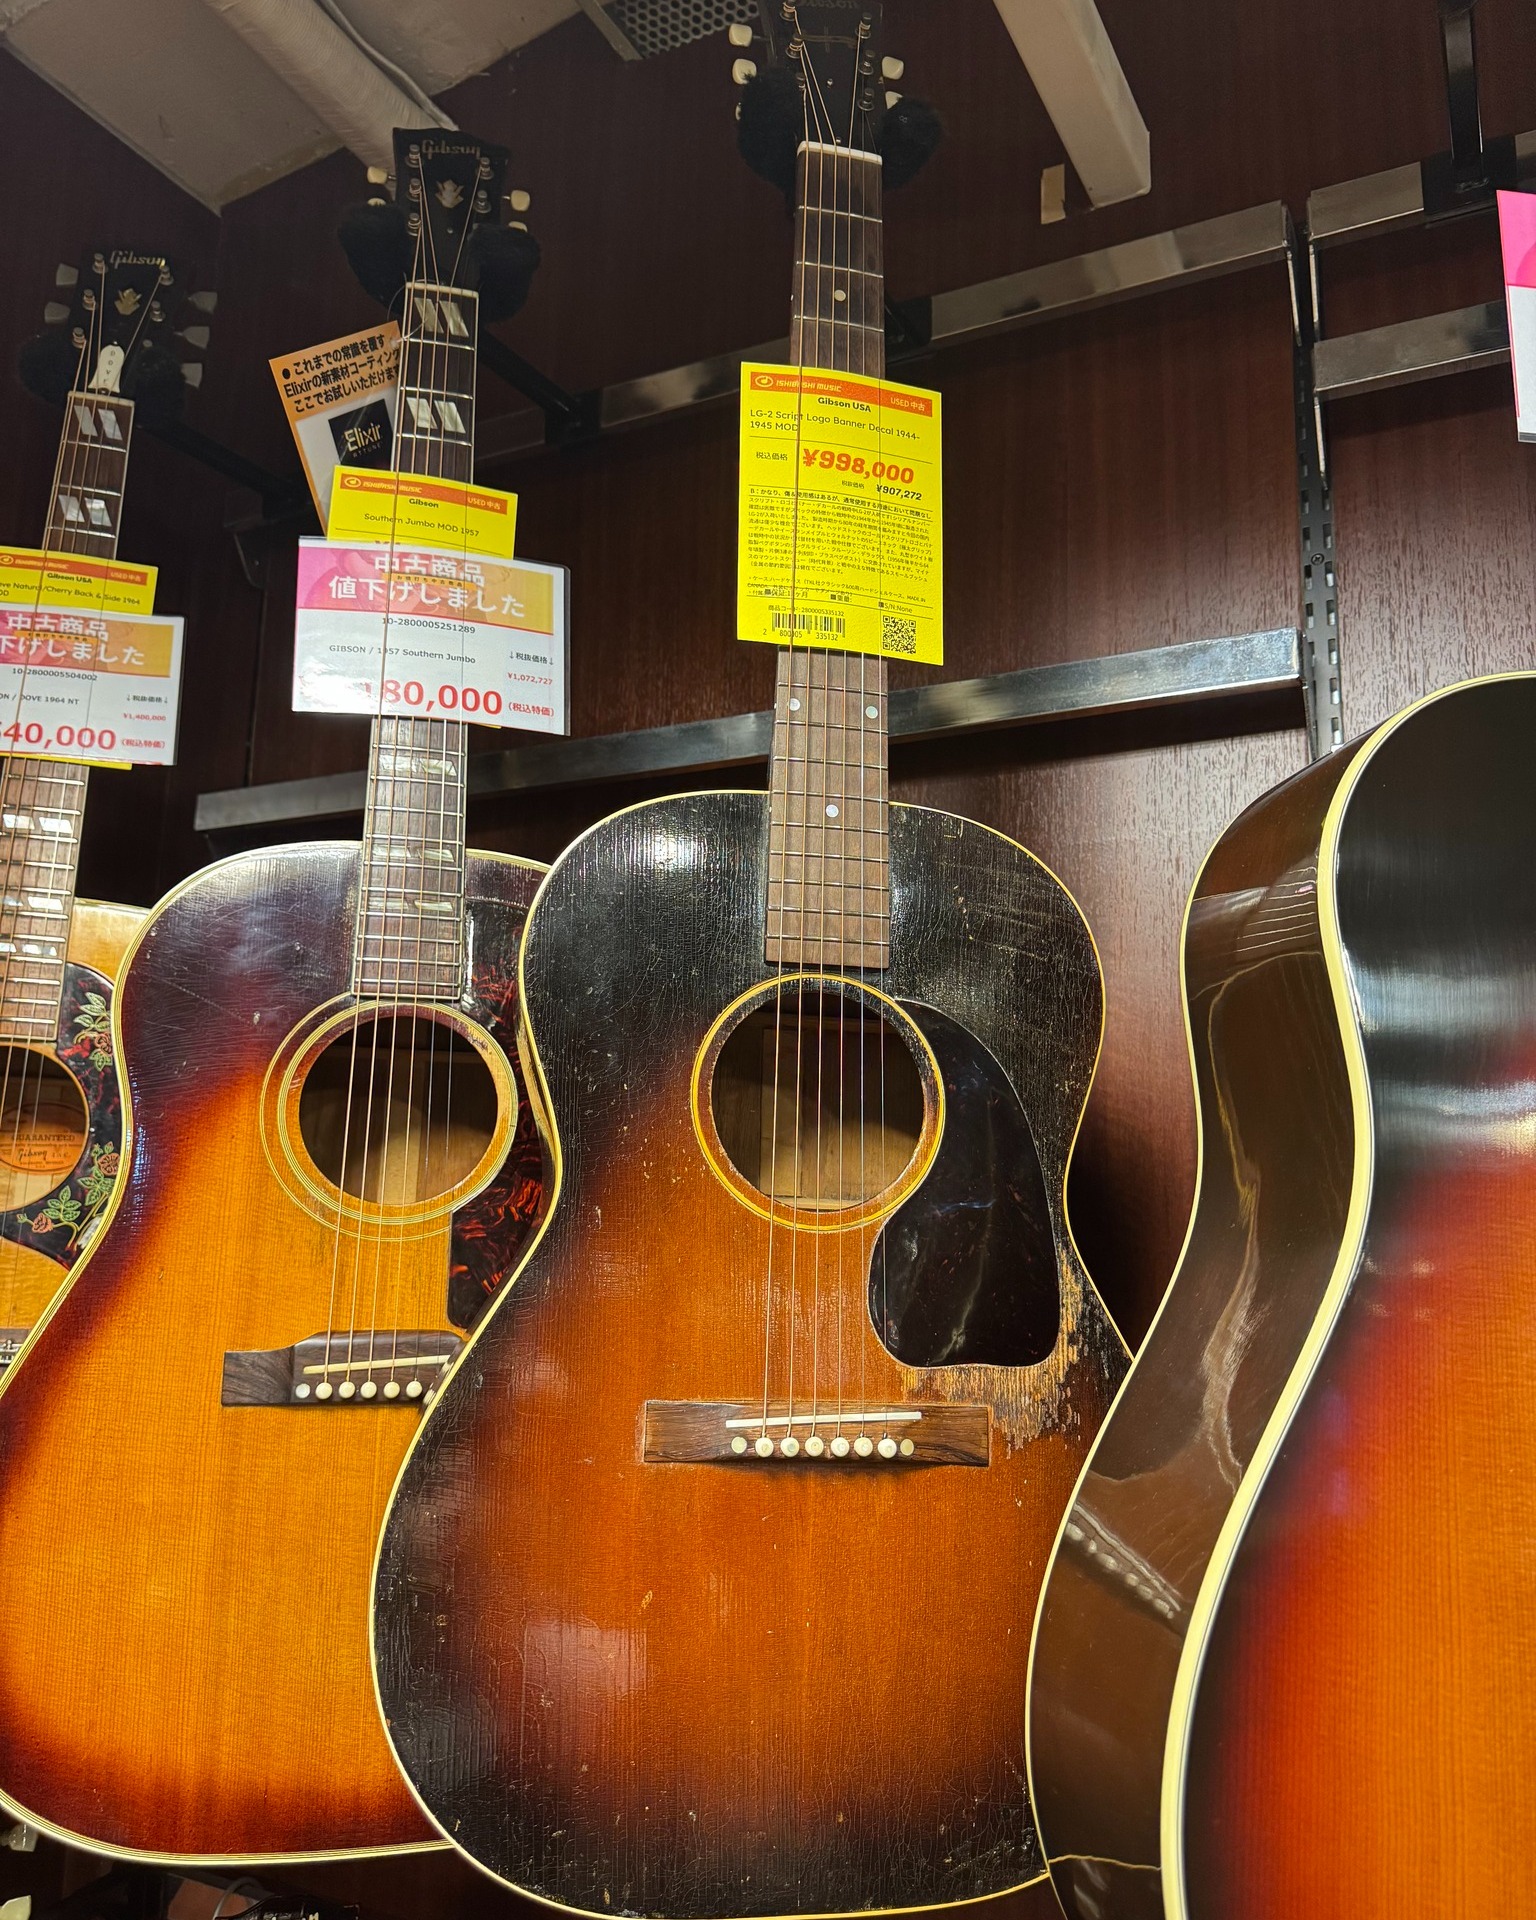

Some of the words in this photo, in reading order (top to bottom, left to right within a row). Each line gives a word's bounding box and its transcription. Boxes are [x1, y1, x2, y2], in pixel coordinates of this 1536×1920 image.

[422, 139, 480, 160] Gibson
[110, 250, 166, 270] Gibson
[293, 334, 385, 376] これまでの常識を覆す
[776, 378, 816, 390] ISHIBSHI
[816, 383, 843, 393] MUSIC
[817, 397, 851, 409] Gibson
[852, 402, 872, 413] USA
[890, 397, 910, 408] USED
[910, 401, 926, 412] 中古
[750, 409, 773, 418] LG-2
[775, 411, 804, 422] Script
[806, 413, 831, 424] Logo
[833, 417, 867, 430] Banner
[869, 423, 894, 436] Decal
[896, 429, 920, 441] 1944-
[750, 421, 772, 430] 1945
[775, 423, 799, 432] MOD
[344, 422, 381, 452] Elixir
[756, 451, 788, 462] 税込価格
[803, 447, 914, 484] ¥998,000
[876, 484, 923, 501] ¥907,272
[409, 498, 439, 509] Gibson
[467, 496, 486, 507] USED
[487, 500, 501, 510] 中古
[364, 512, 403, 524] Southern
[405, 517, 435, 529] Jumbo
[437, 522, 459, 533] MOD
[461, 527, 480, 537] 1957
[374, 553, 486, 587] 中古商品
[74, 590, 94, 599] Back
[103, 594, 121, 603] Side
[123, 596, 141, 605] 1964
[328, 575, 525, 618] 値下げしました
[801, 606, 845, 617] 2800005335132
[7, 613, 109, 642] 中古商品
[382, 617, 476, 634] 10-2800005251289
[816, 631, 839, 642] 335132
[329, 644, 367, 654] GIBSON
[402, 648, 444, 660] Southern
[446, 653, 476, 664] Jumbo
[12, 667, 98, 681] 10-2800005504002
[507, 672, 553, 686] ¥1,072,727
[45, 696, 66, 704] 1964
[67, 698, 80, 706] NT
[508, 703, 555, 718] （税込特価）
[0, 722, 116, 750] 40,000
